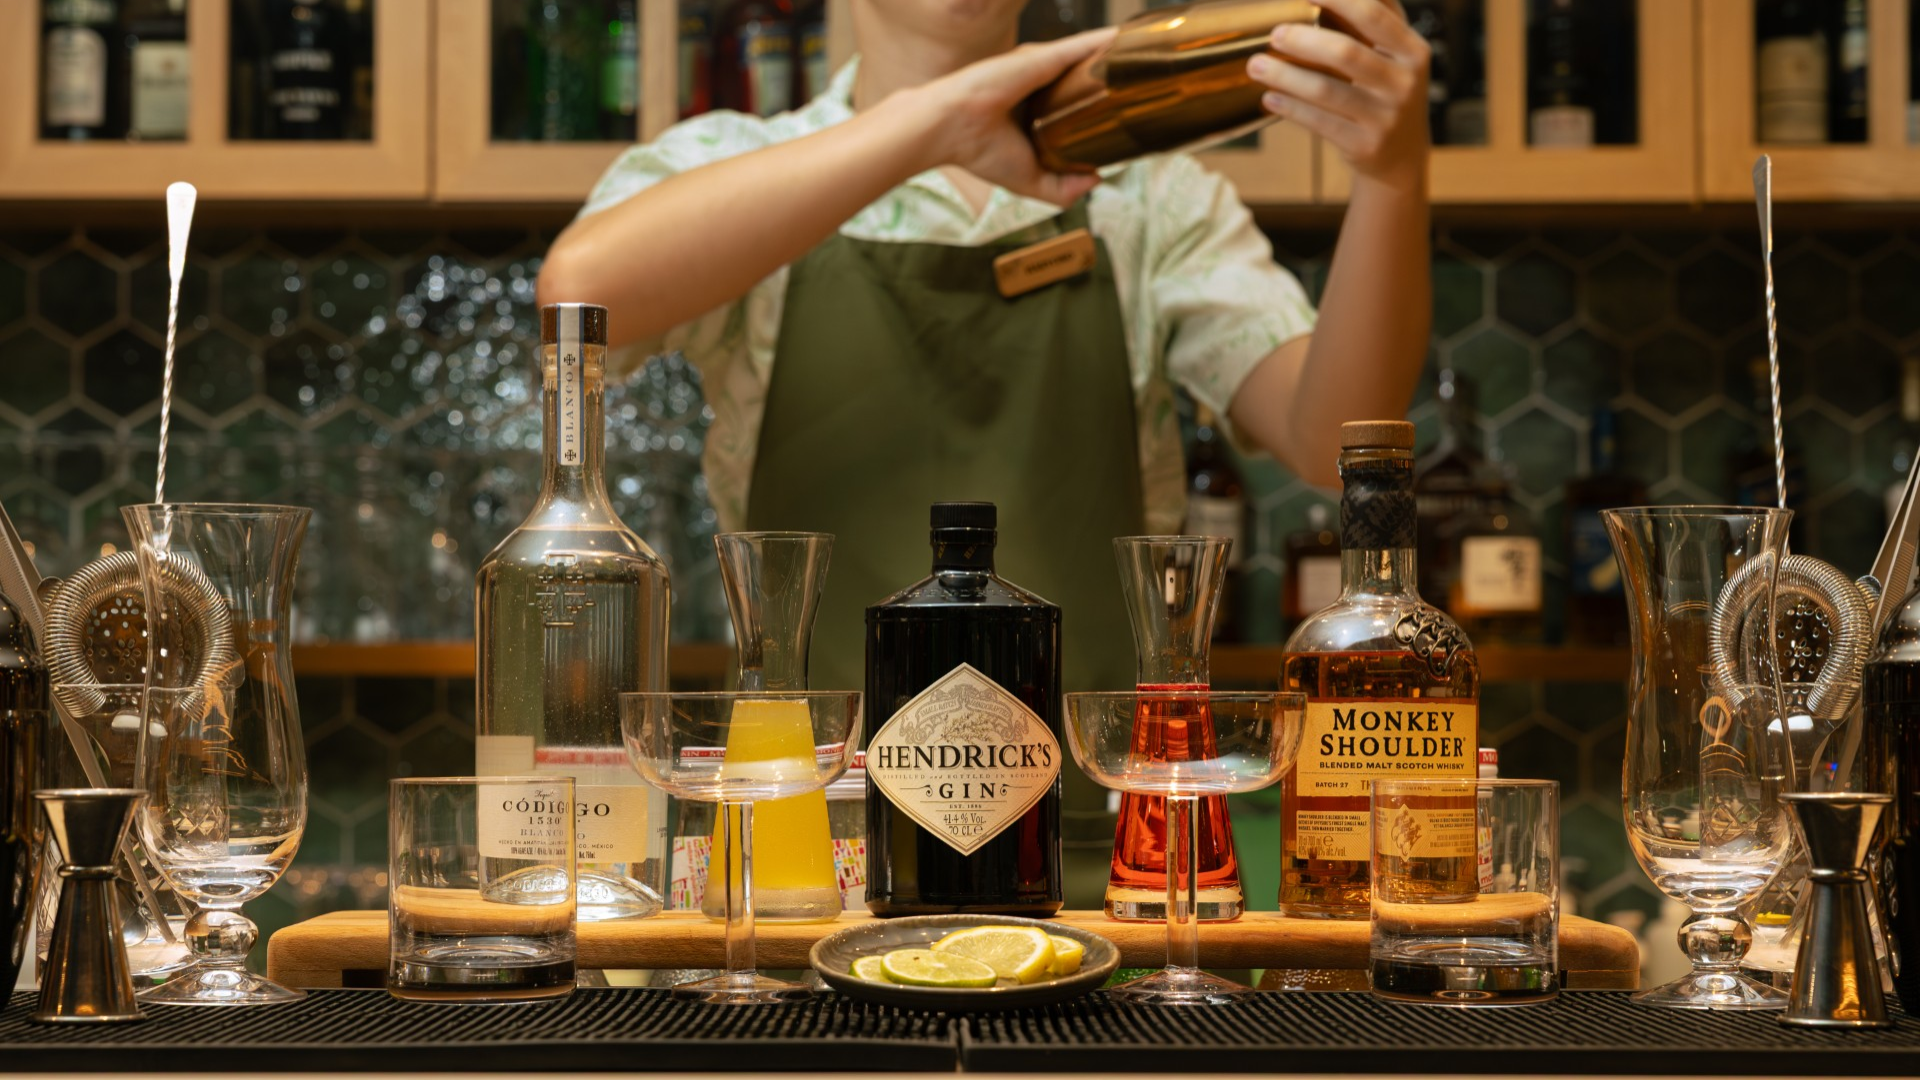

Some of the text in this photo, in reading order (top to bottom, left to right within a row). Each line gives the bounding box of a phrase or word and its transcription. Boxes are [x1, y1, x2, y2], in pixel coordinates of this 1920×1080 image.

[565, 370, 574, 443] BLANCO
[1332, 708, 1455, 731] MONKEY
[877, 742, 1052, 769] HENDRICK'S
[1320, 733, 1463, 757] SHOULDER
[1319, 761, 1363, 769] BLENDED
[1366, 761, 1393, 769] MALT
[939, 782, 996, 799] GIN
[948, 825, 959, 836] 70
